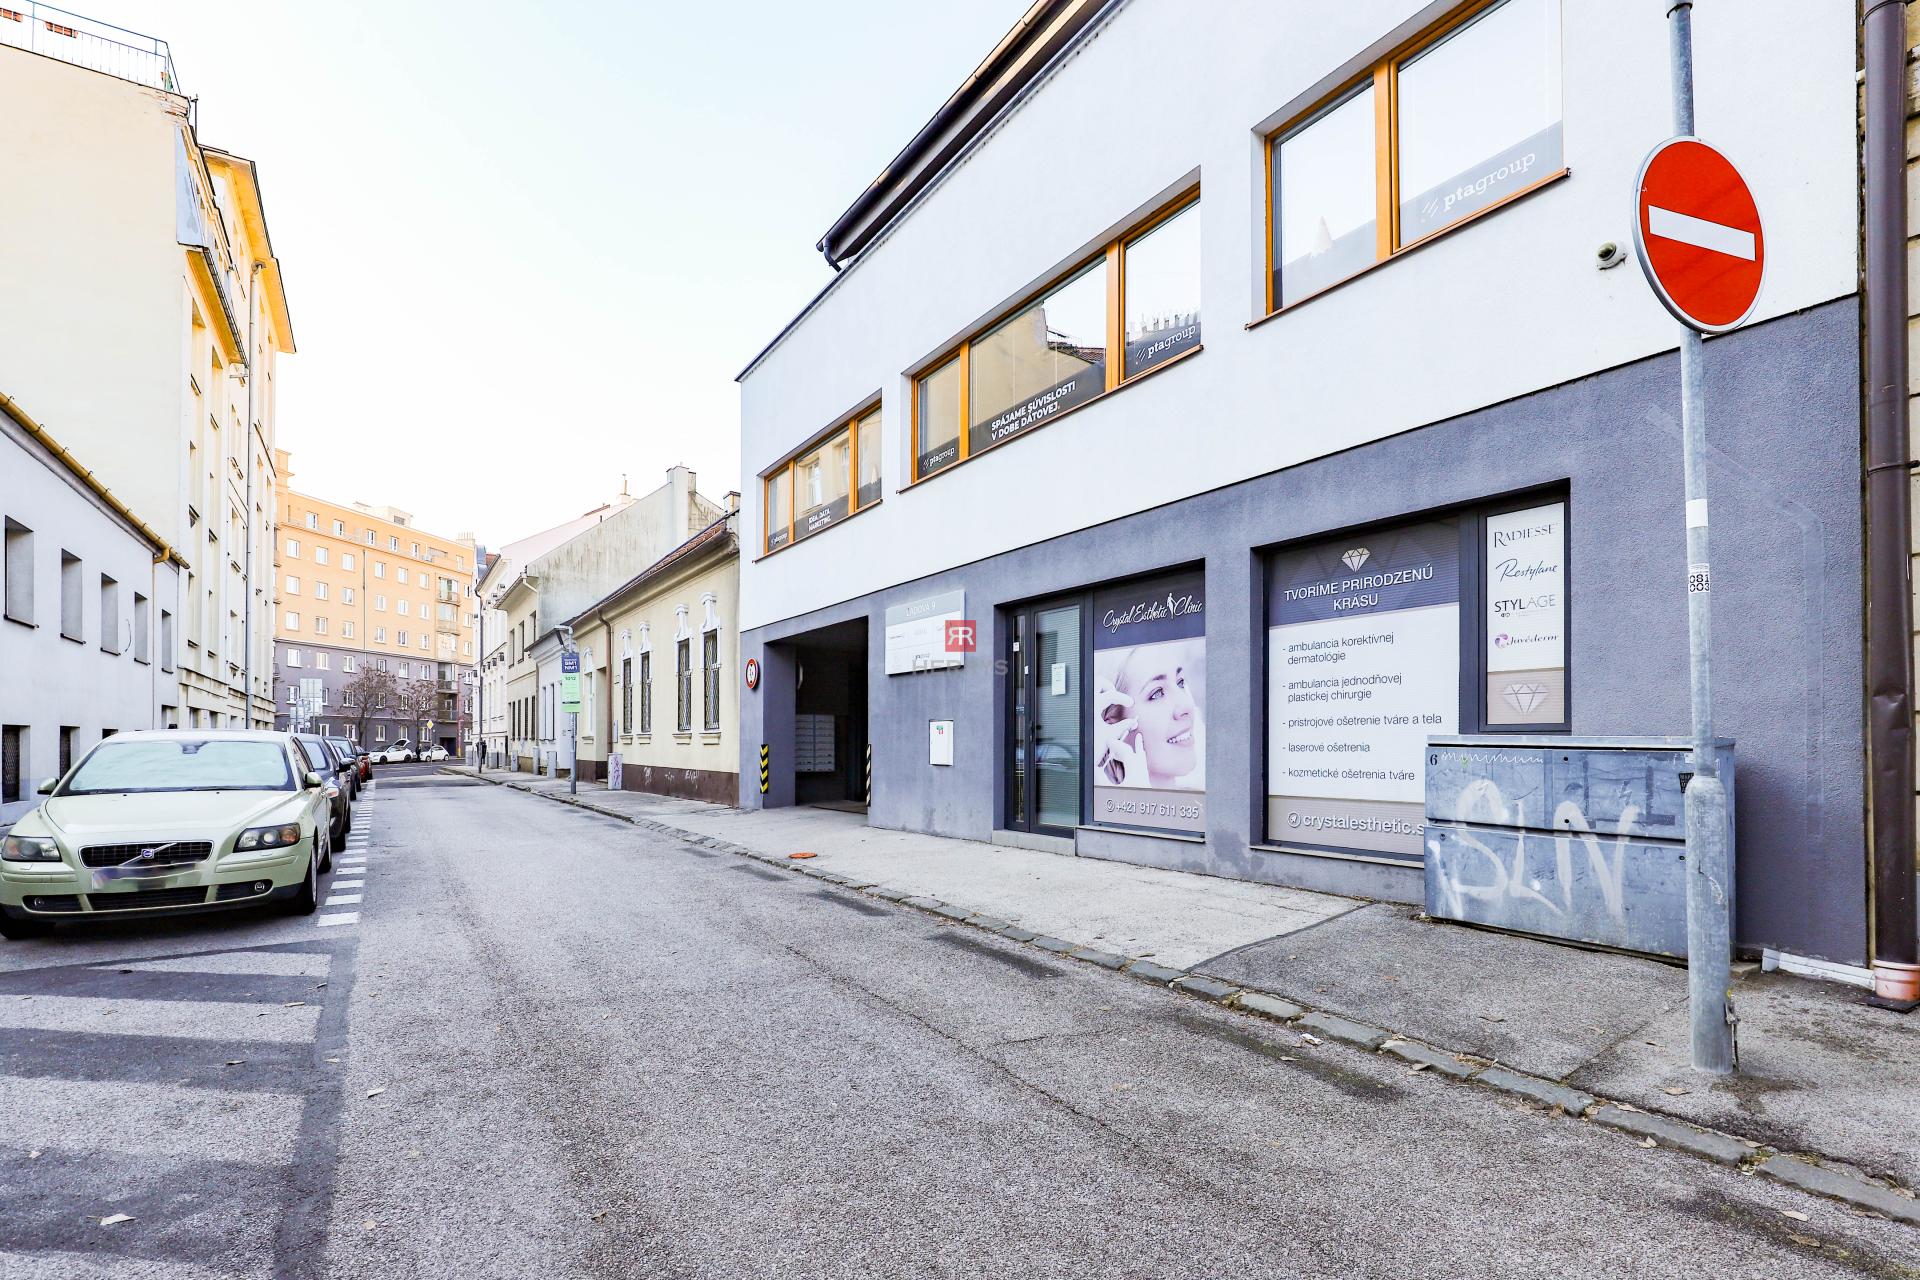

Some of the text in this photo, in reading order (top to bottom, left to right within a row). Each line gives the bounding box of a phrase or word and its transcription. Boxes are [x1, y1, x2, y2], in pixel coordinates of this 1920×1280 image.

[1442, 153, 1536, 213] ptagroup
[1147, 325, 1196, 358] ptagroup
[991, 380, 1076, 431] SPÁJAME SÚVISLOSTI
[991, 430, 998, 441] V
[998, 419, 1020, 438] DOBE
[929, 447, 955, 467] ptagroup
[1495, 558, 1558, 583] Restylane
[1284, 563, 1433, 601] TVORÍME PRIRODZENÚ
[1333, 593, 1379, 611] KRÁSU
[1494, 594, 1556, 613] STYLAGE
[1103, 594, 1203, 633] Crystal Esthetic Clinic
[1288, 632, 1394, 653] ambulancia korektívnej
[1287, 651, 1346, 665] dermatológie
[1288, 672, 1402, 690] ambulancia jednodňovej
[1287, 689, 1372, 704] plastickej chirurgie
[1336, 715, 1381, 726] ošetrenie
[1384, 714, 1409, 725] tváre
[1412, 716, 1419, 724] a
[1422, 714, 1442, 724] tela
[1288, 742, 1371, 752] laserové ošetrenia
[1429, 754, 1438, 766] 6
[1288, 768, 1415, 780] kozmetické ošetrenia tváre
[1116, 801, 1200, 819] +421 917 611 335
[1303, 814, 1429, 836] crystalesthetic.s
